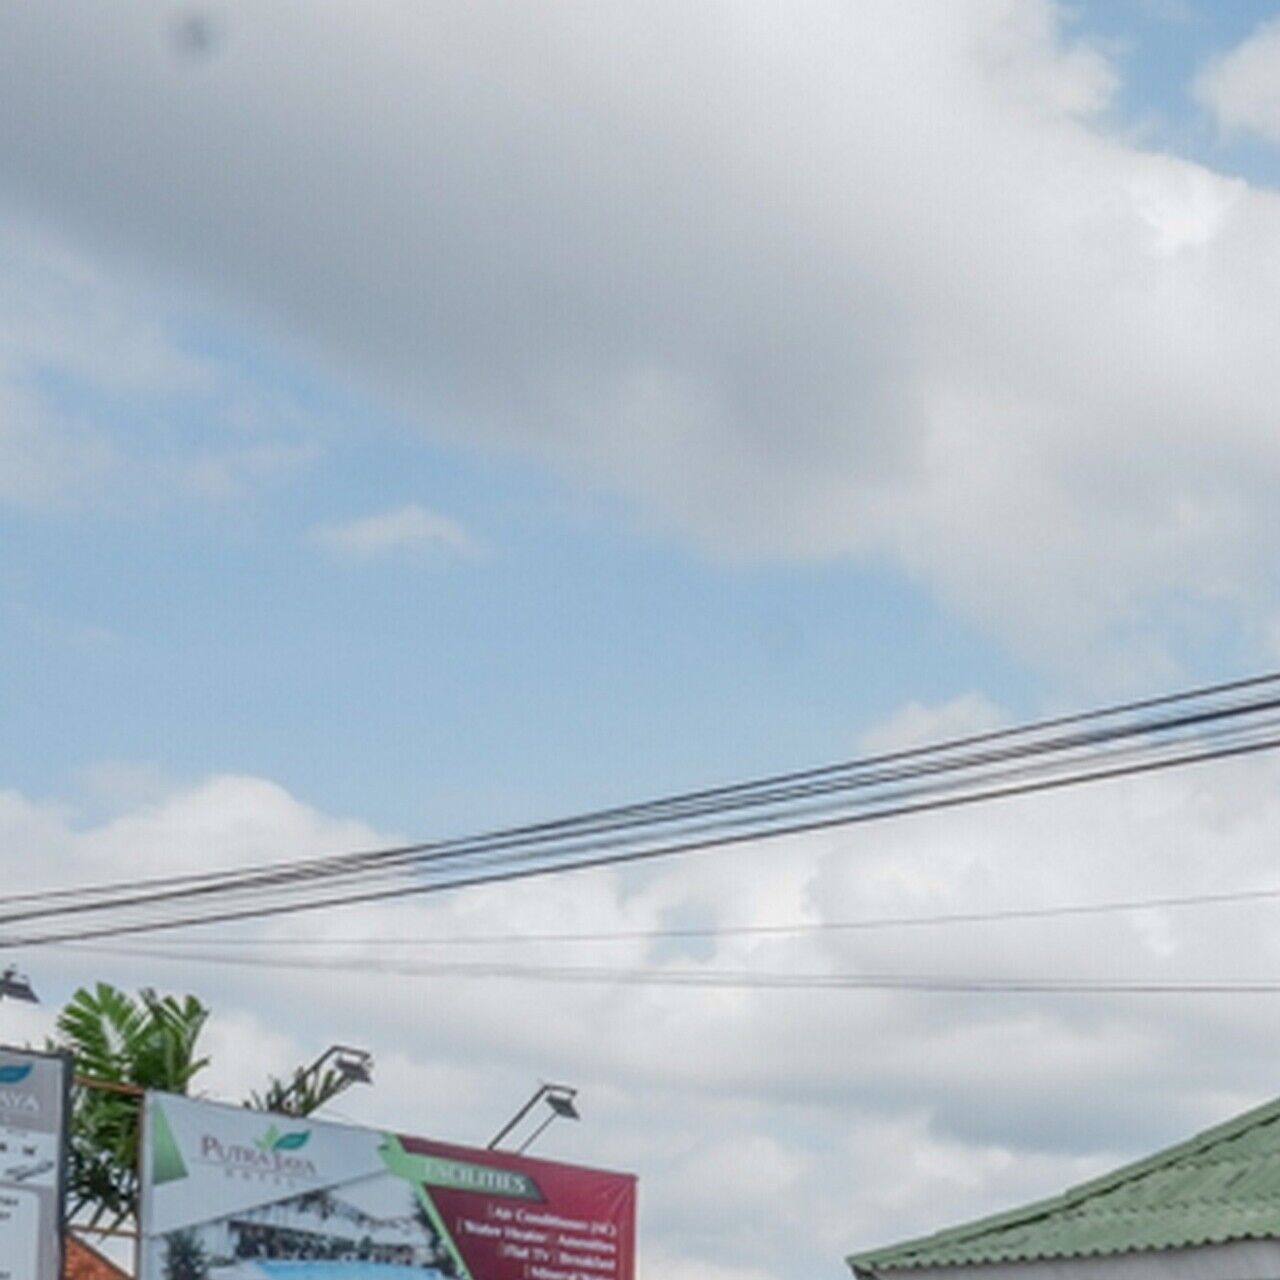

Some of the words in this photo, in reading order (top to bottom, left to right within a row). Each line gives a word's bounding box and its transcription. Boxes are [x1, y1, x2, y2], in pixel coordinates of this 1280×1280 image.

[201, 1134, 269, 1166] PUTRA
[424, 1162, 527, 1194] FACILITIES
[464, 1220, 501, 1237] Water
[504, 1225, 547, 1242] Heater
